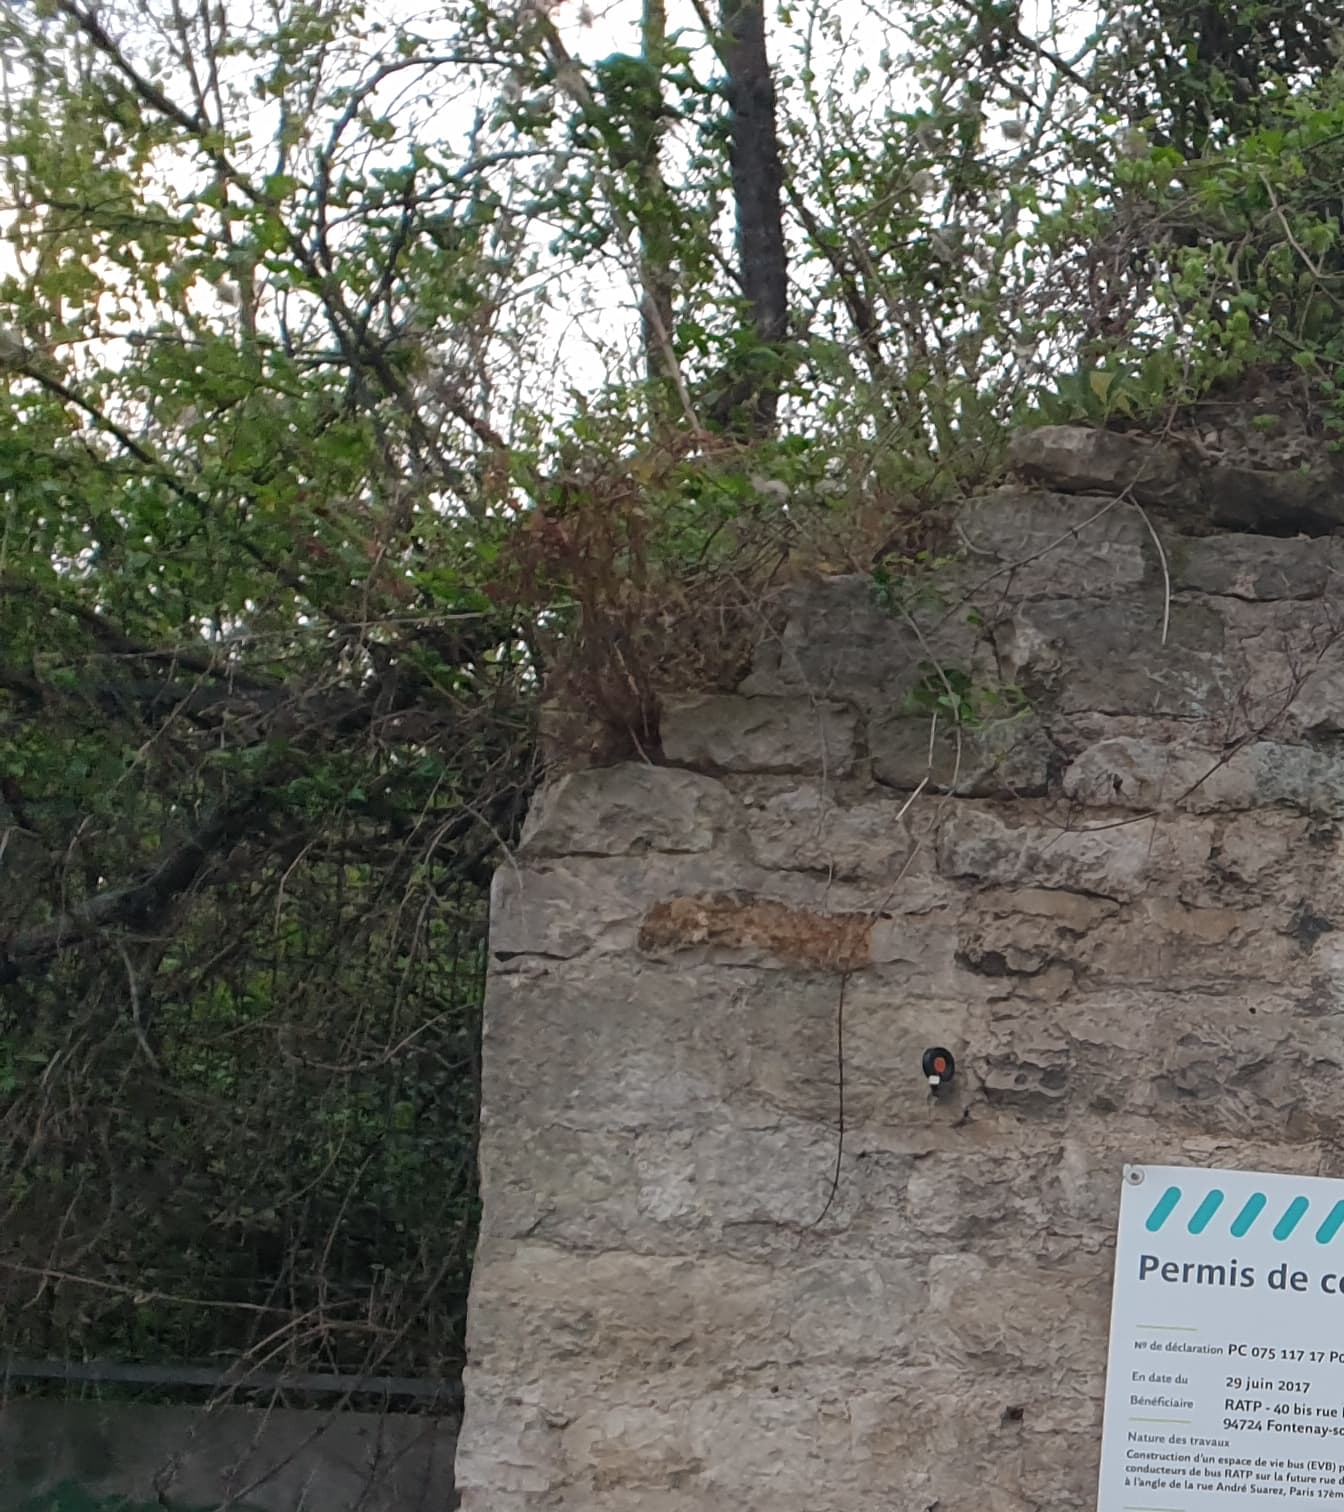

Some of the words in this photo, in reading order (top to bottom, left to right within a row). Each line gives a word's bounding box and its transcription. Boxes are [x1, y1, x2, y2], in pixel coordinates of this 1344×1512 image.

[1138, 1254, 1256, 1288] Permis
[1267, 1263, 1309, 1292] de
[1150, 1341, 1163, 1351] de
[1165, 1341, 1224, 1355] déclaration
[1228, 1344, 1247, 1357] PC
[1251, 1347, 1276, 1360] 075
[1281, 1349, 1304, 1362] 117
[1309, 1351, 1325, 1363] 17
[1132, 1371, 1146, 1382] En
[1148, 1372, 1172, 1384] date
[1174, 1373, 1188, 1385] du
[1226, 1377, 1242, 1389] 29
[1246, 1377, 1273, 1391] juin
[1278, 1380, 1311, 1394] 2017
[1130, 1394, 1194, 1409] Bénéficiaire
[1225, 1398, 1262, 1412] RATP
[1273, 1403, 1290, 1416] 40
[1294, 1403, 1312, 1416] bis
[1316, 1407, 1338, 1418] rue
[1223, 1418, 1262, 1431] 94724
[1127, 1431, 1165, 1444] Nature
[1168, 1433, 1187, 1445] des
[1190, 1436, 1230, 1448] travaux
[1126, 1449, 1191, 1464] Construction
[1193, 1453, 1215, 1464] d'un
[1218, 1457, 1251, 1467] espace
[1255, 1457, 1267, 1467] de
[1270, 1458, 1284, 1468] vie
[1287, 1459, 1304, 1469] bus
[1307, 1460, 1336, 1472] (EVB)
[1125, 1462, 1187, 1476] conducteurs
[1189, 1466, 1202, 1476] de
[1204, 1467, 1222, 1478] bus
[1224, 1469, 1253, 1479] RATP
[1255, 1472, 1271, 1481] sur
[1274, 1471, 1283, 1481] la
[1286, 1471, 1317, 1483] future
[1319, 1476, 1336, 1485] rue
[1133, 1476, 1167, 1489] l'angle
[1169, 1478, 1182, 1488] de
[1184, 1479, 1194, 1490] la
[1196, 1483, 1213, 1491] rue
[1216, 1482, 1247, 1493] André
[1289, 1486, 1314, 1497] Paris
